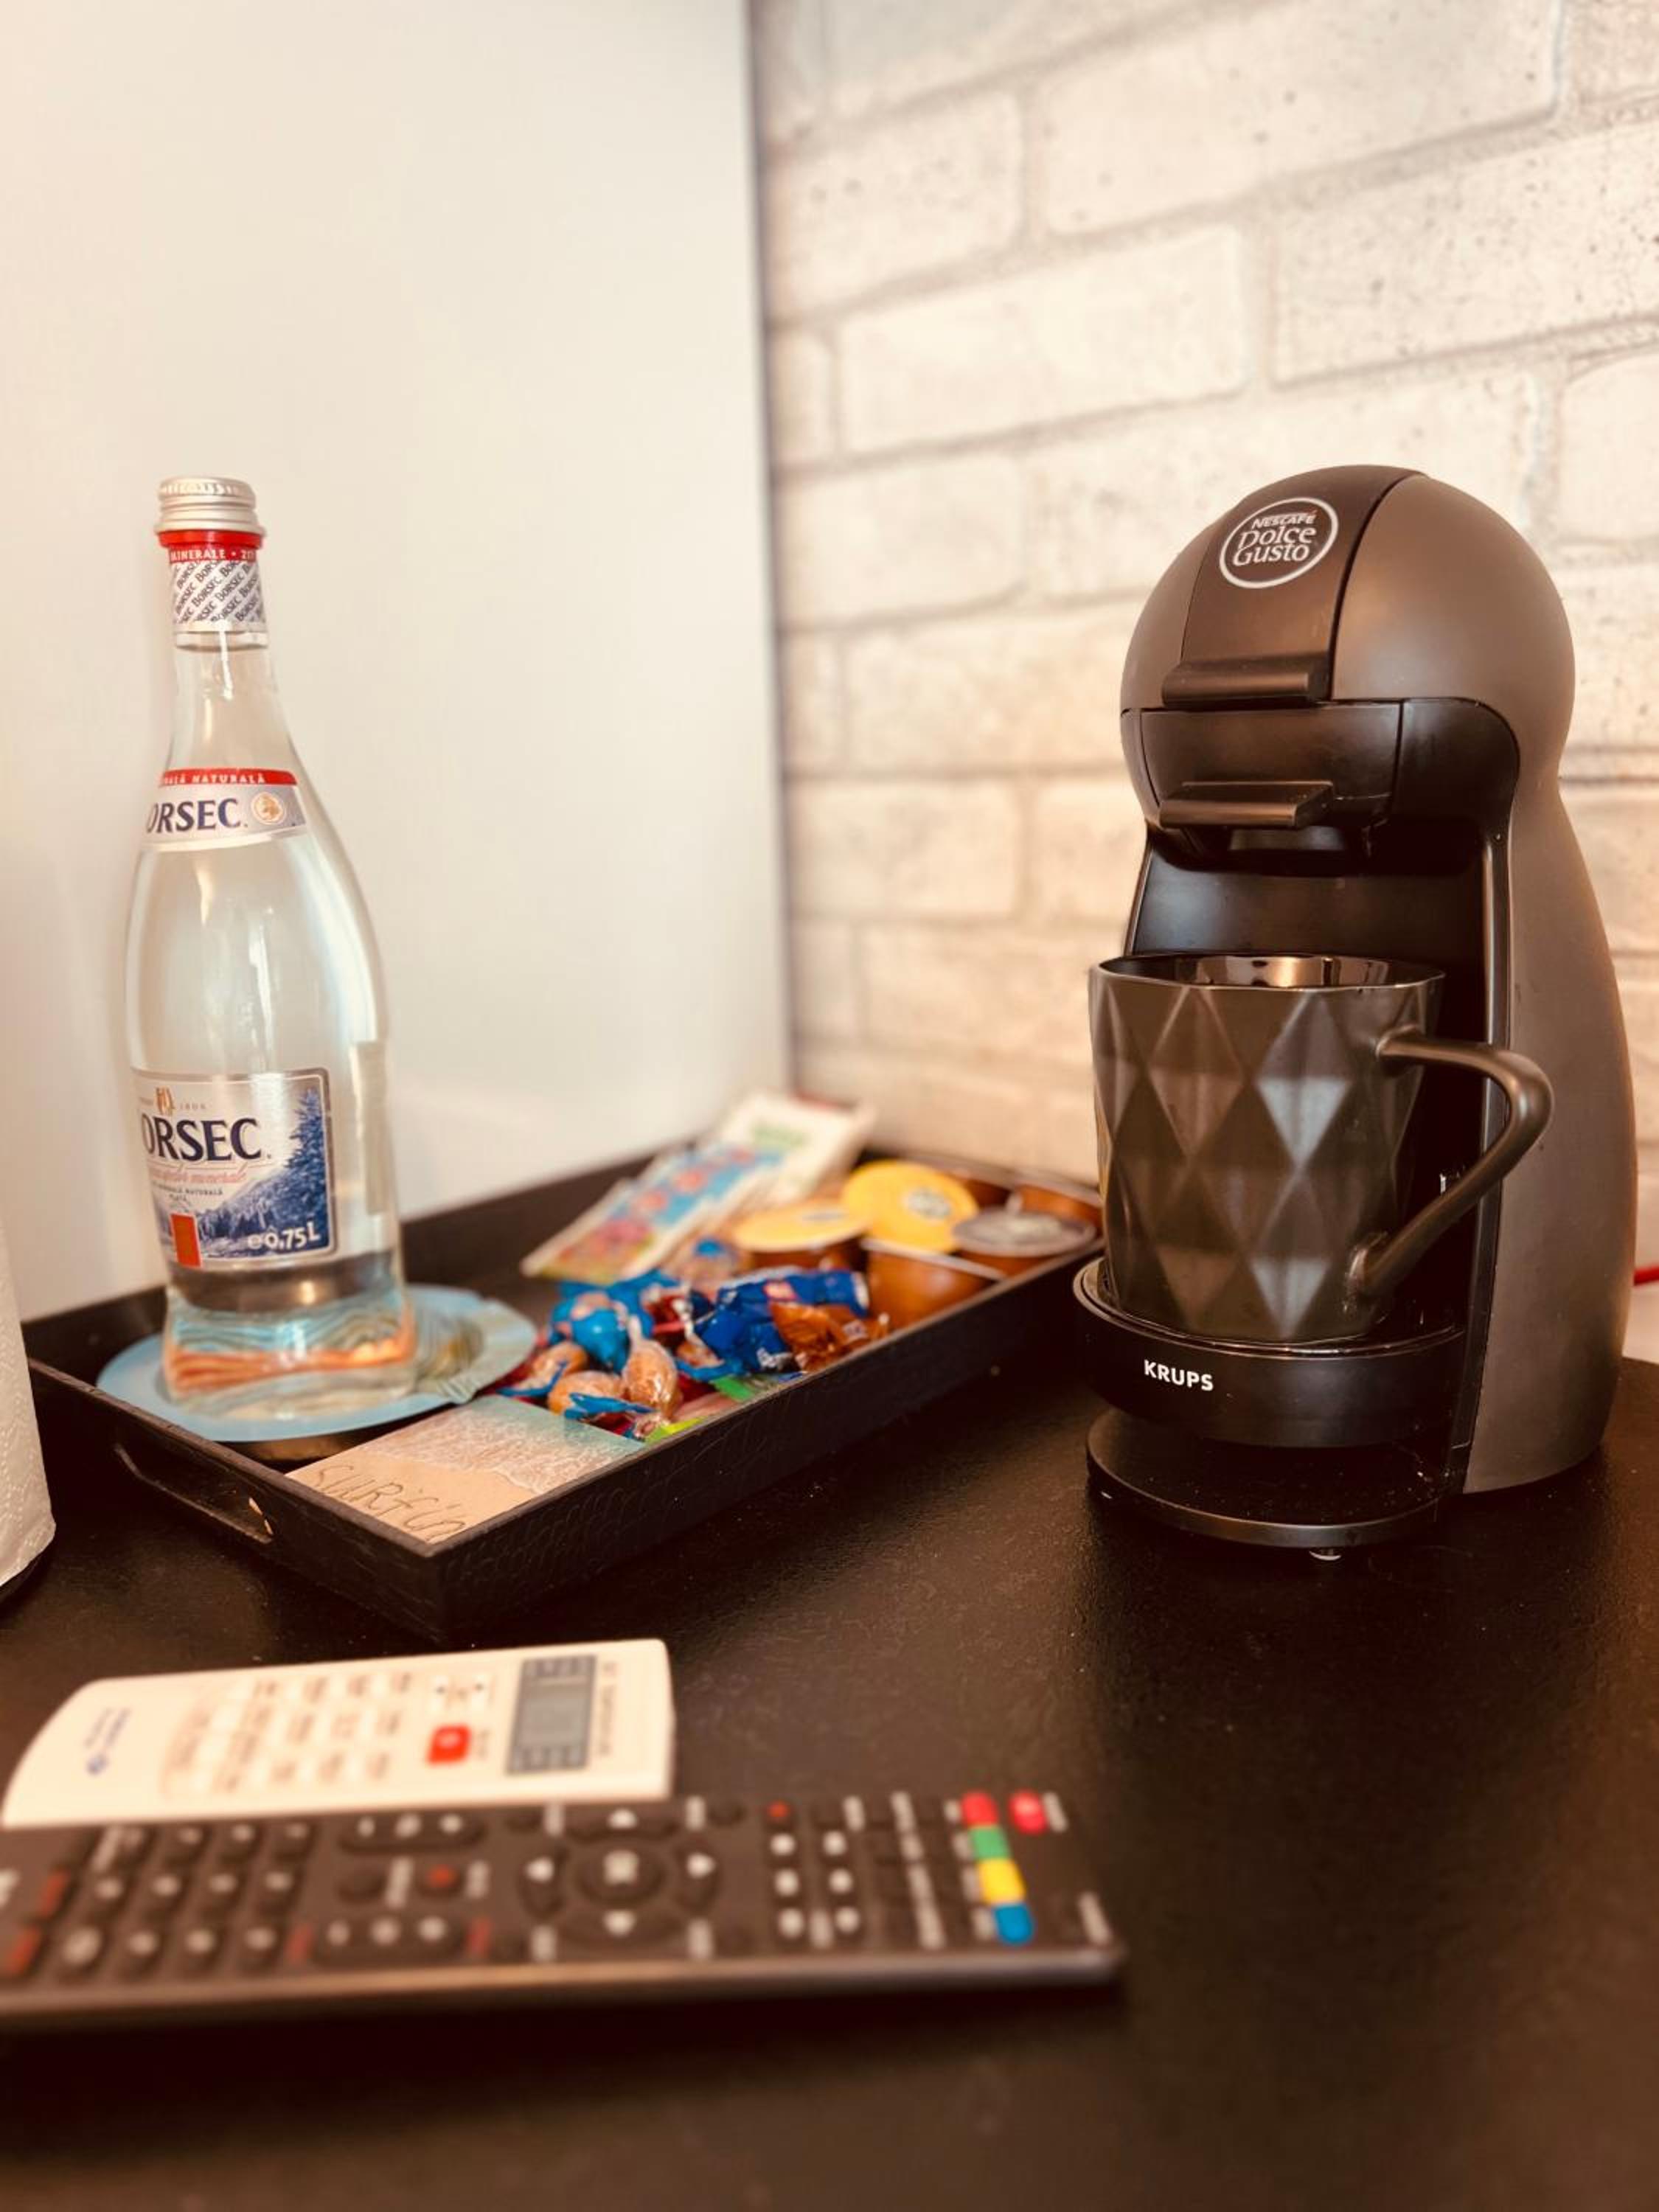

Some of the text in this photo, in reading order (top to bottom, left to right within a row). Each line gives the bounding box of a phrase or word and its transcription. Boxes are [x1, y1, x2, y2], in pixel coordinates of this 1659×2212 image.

[1252, 510, 1318, 529] NESCAFÉ
[1238, 526, 1317, 550] Dolce
[1233, 544, 1310, 566] Gusto
[192, 577, 222, 607] BORSEC
[215, 572, 244, 602] BORSEC
[1144, 1359, 1214, 1391] KRUPS
